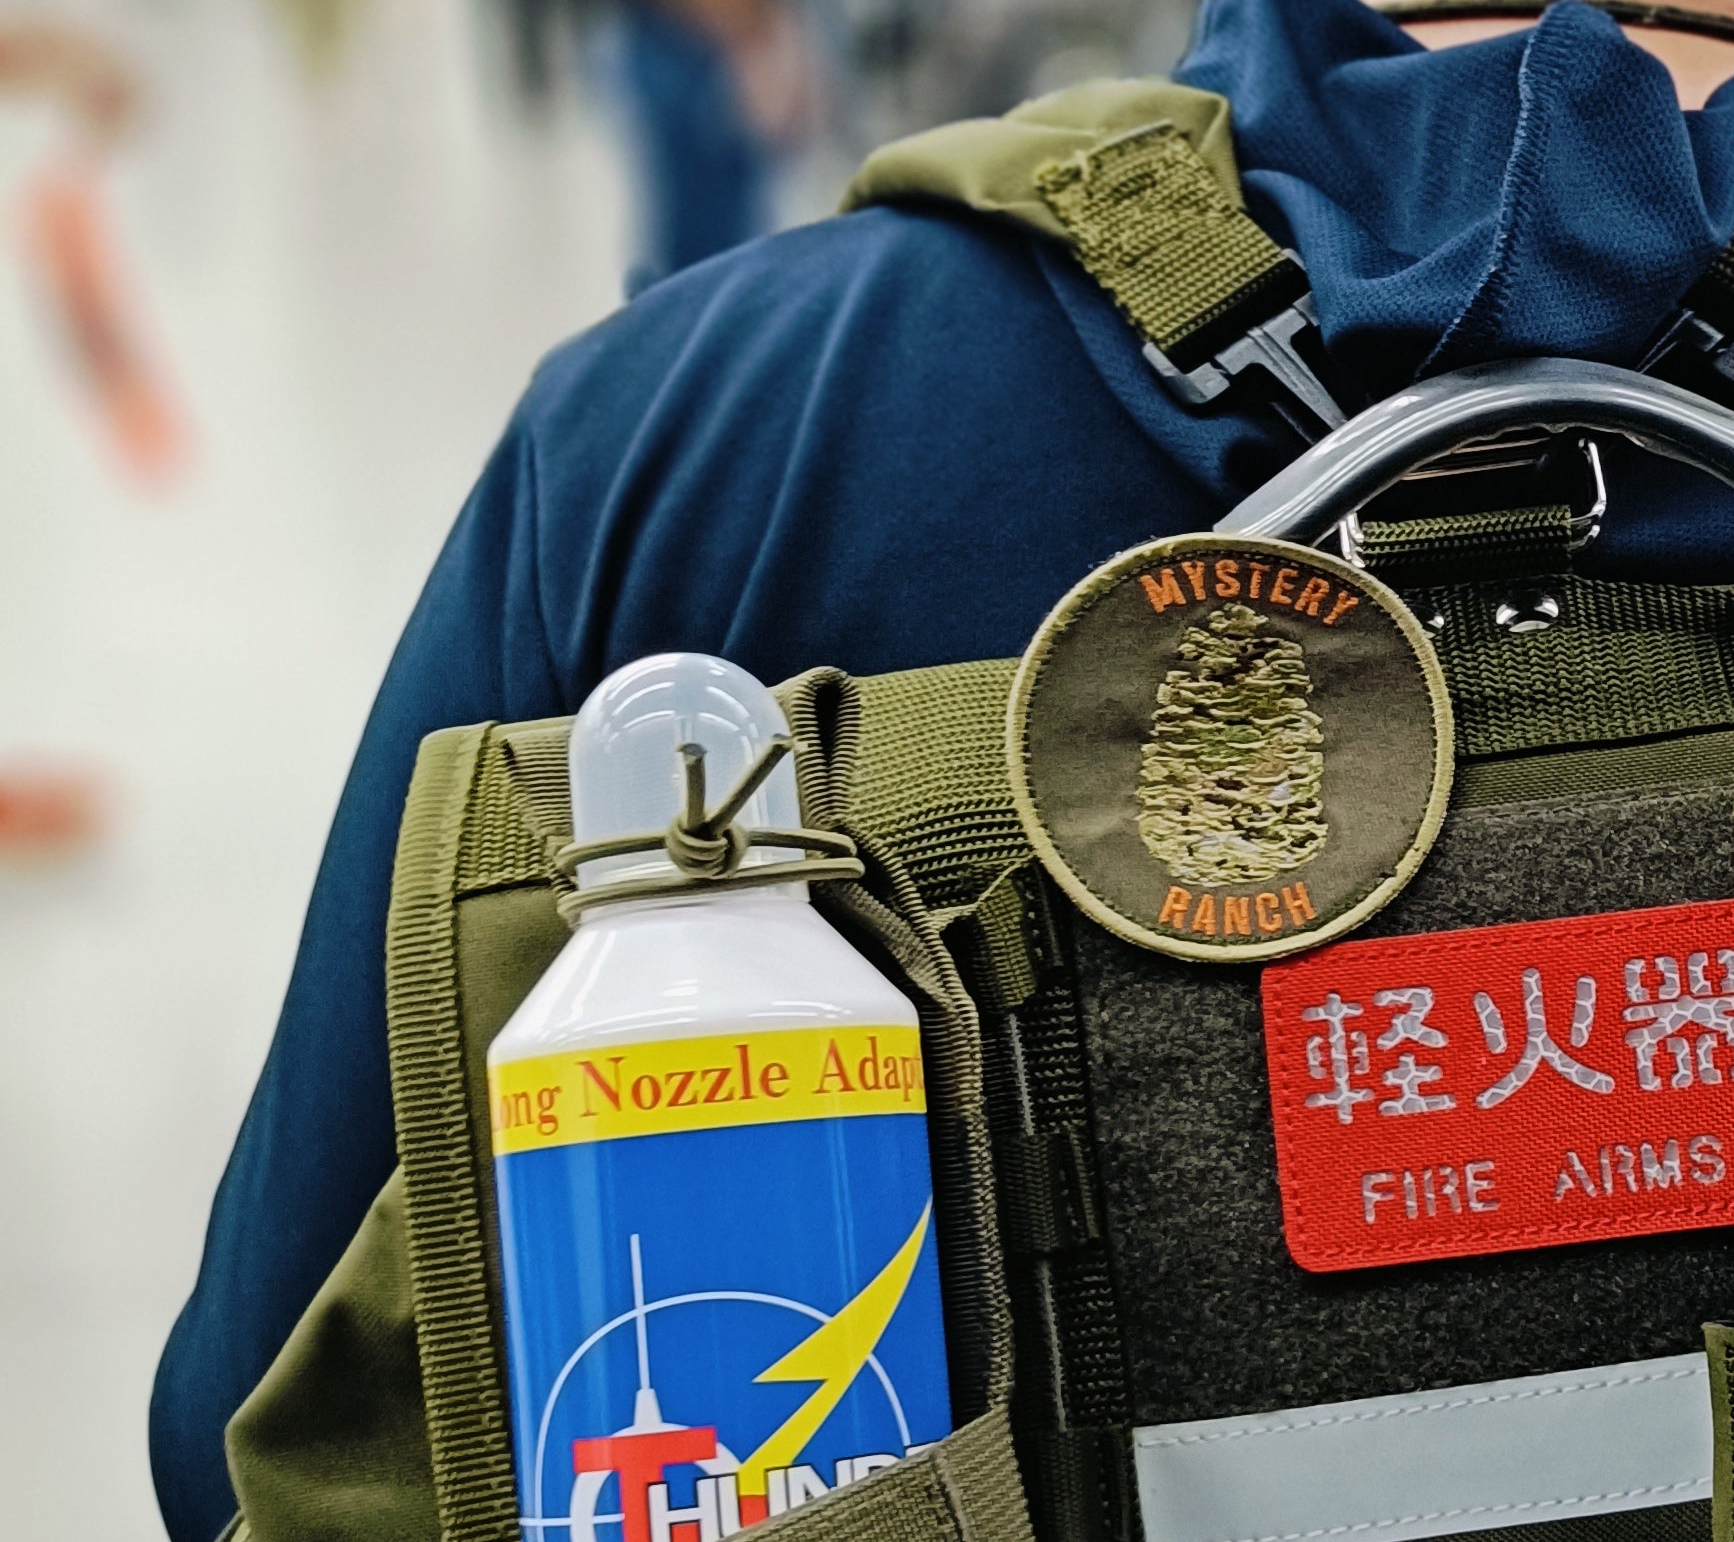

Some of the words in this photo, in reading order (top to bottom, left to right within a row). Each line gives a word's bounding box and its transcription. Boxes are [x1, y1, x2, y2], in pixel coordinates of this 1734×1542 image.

[1138, 559, 1359, 626] MYSTERY
[1158, 882, 1317, 937] RANCH
[492, 1085, 562, 1136] ong
[574, 1042, 790, 1118] Nozzle
[1362, 1160, 1501, 1224] FIRE
[1555, 1135, 1727, 1202] ARMS
